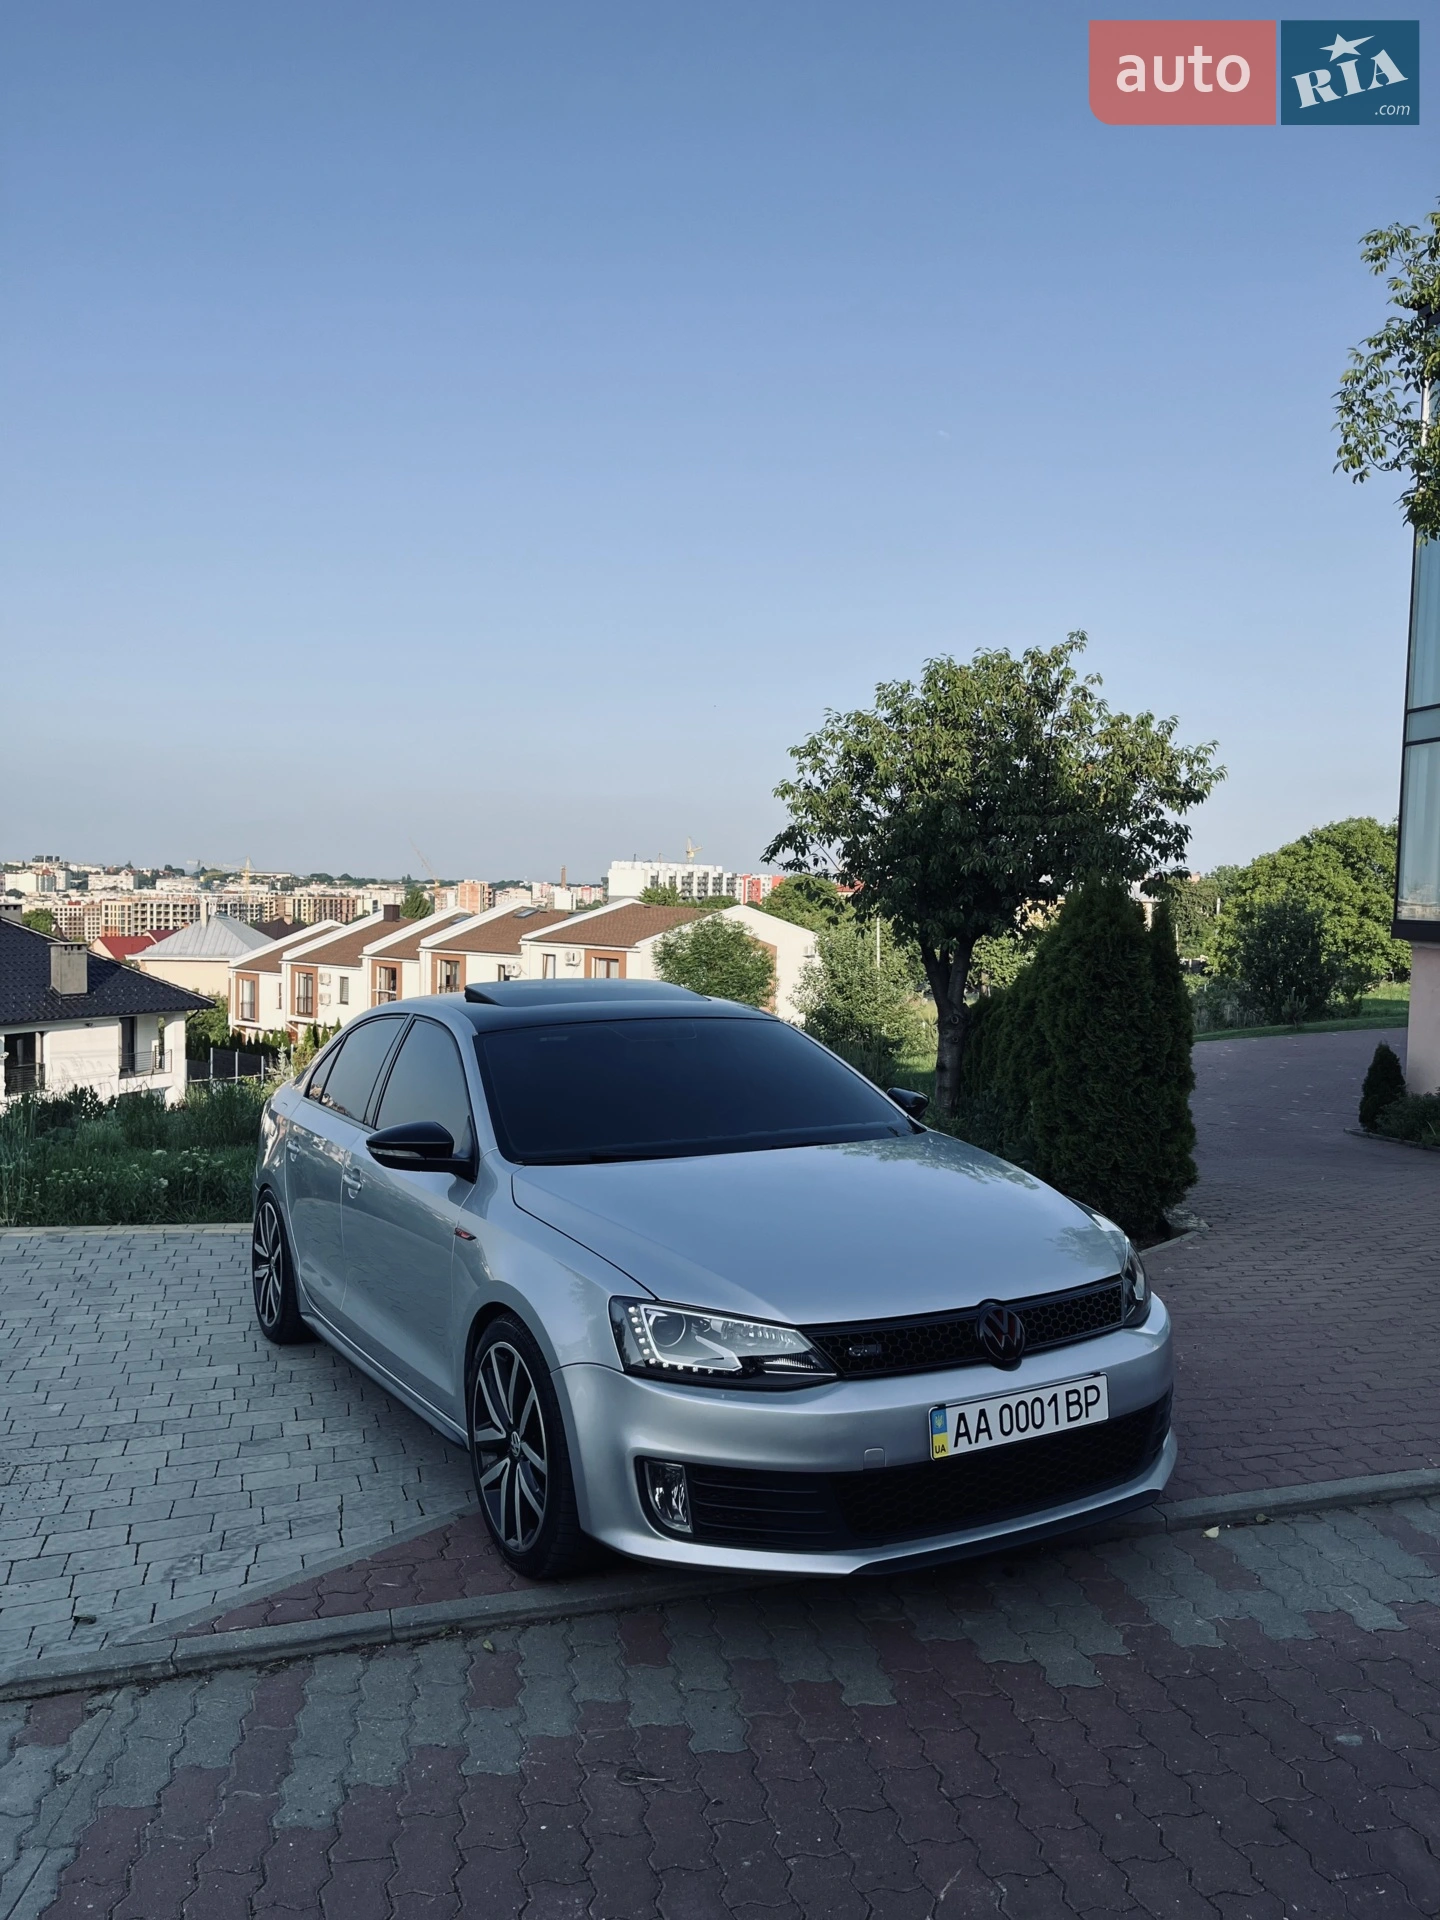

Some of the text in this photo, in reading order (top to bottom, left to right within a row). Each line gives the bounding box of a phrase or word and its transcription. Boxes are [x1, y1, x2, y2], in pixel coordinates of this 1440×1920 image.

[953, 1384, 1100, 1447] AA 0001 BP
[934, 1444, 947, 1454] UA
